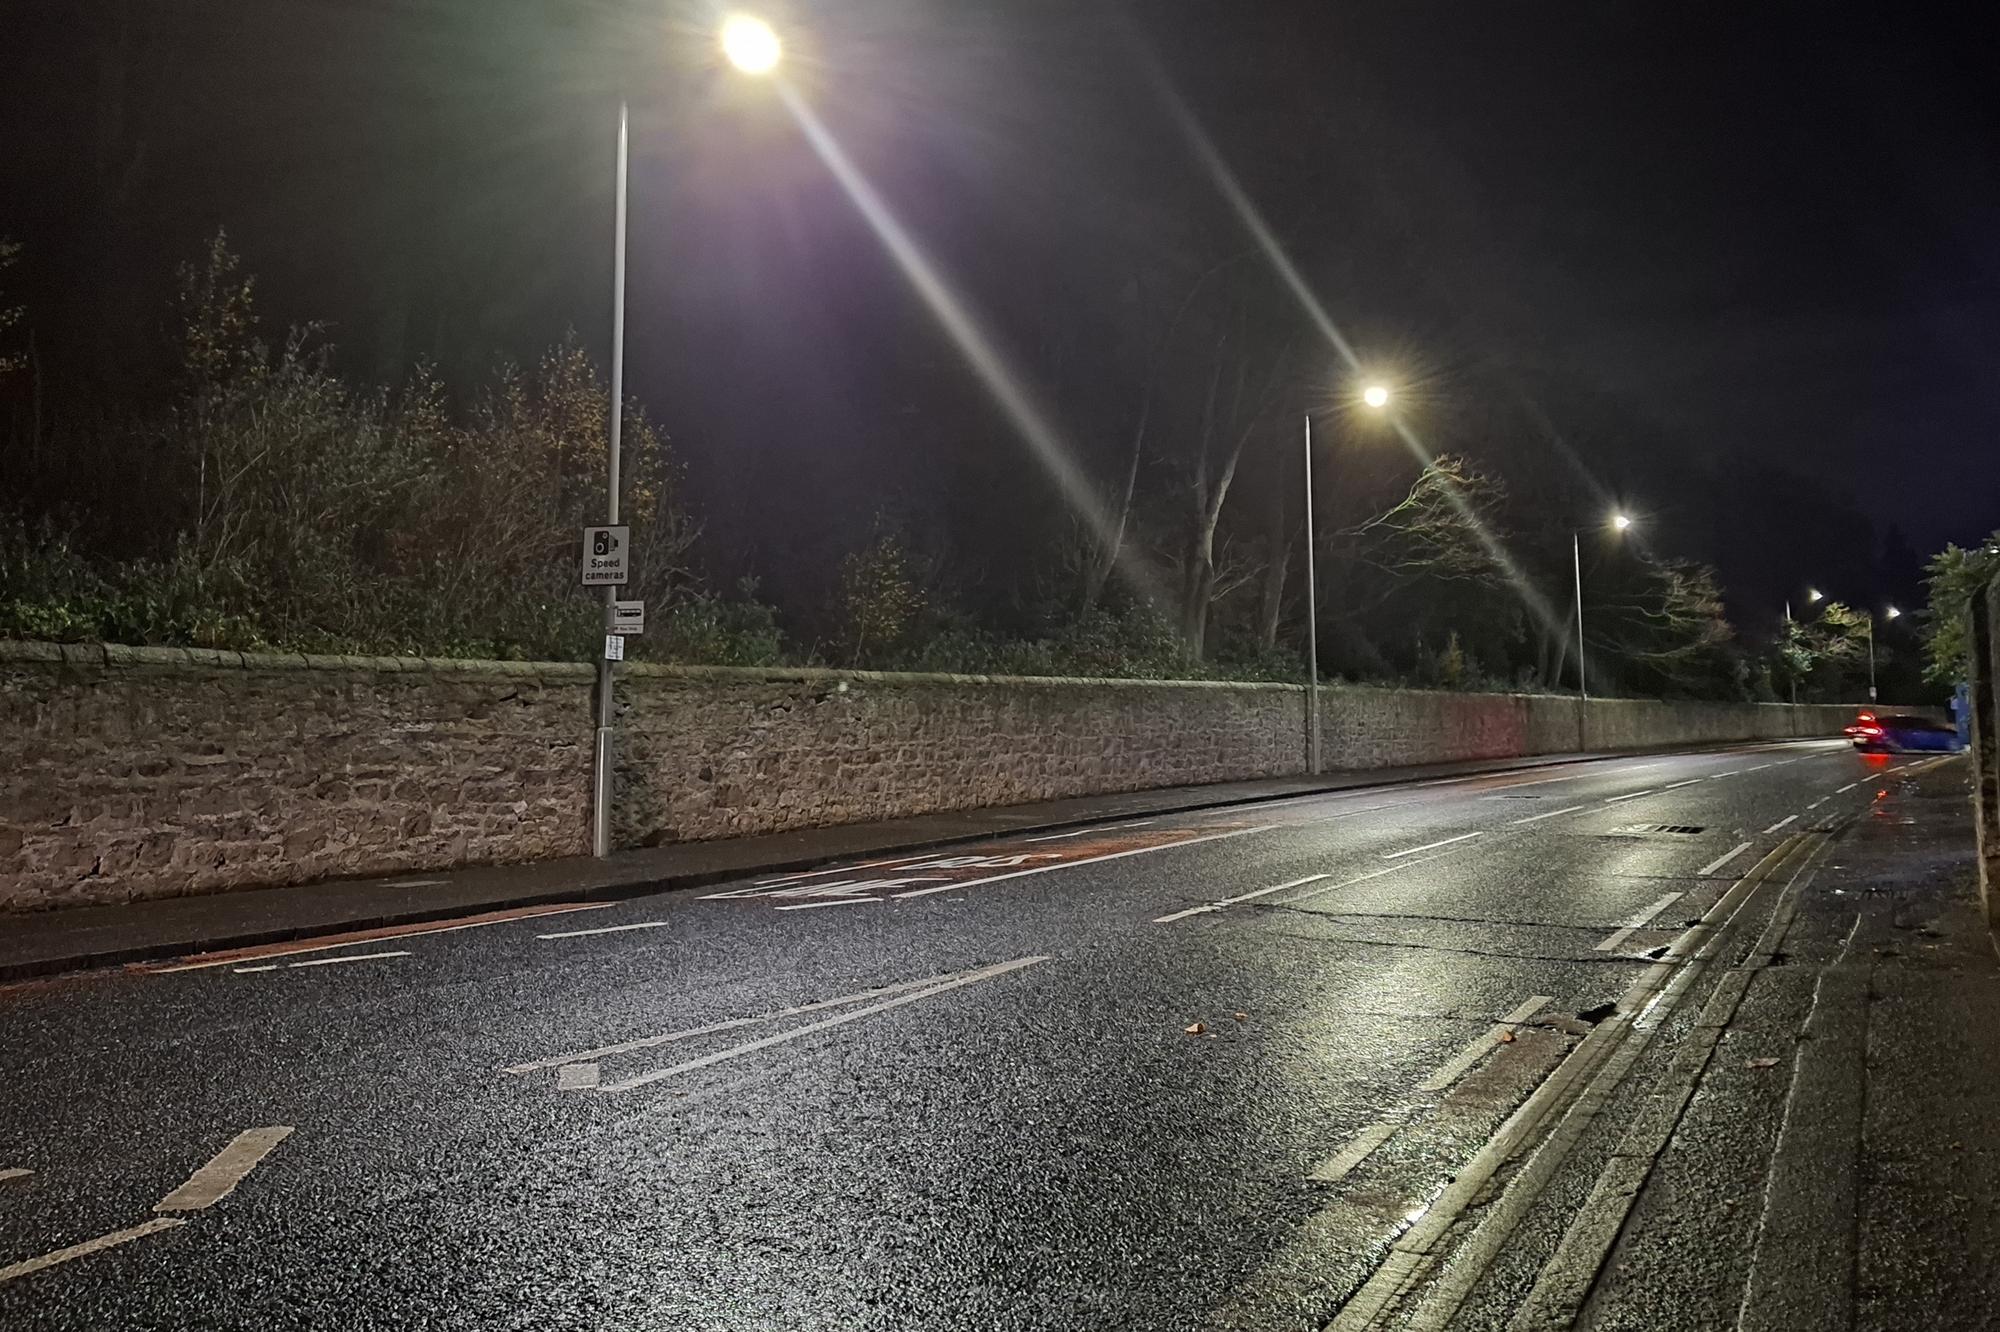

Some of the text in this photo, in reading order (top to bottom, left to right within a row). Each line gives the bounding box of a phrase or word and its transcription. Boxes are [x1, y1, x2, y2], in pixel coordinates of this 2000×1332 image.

[591, 558, 620, 569] Speed
[585, 571, 624, 580] cameras
[890, 853, 1063, 871] BUS
[694, 877, 953, 900] LANE
